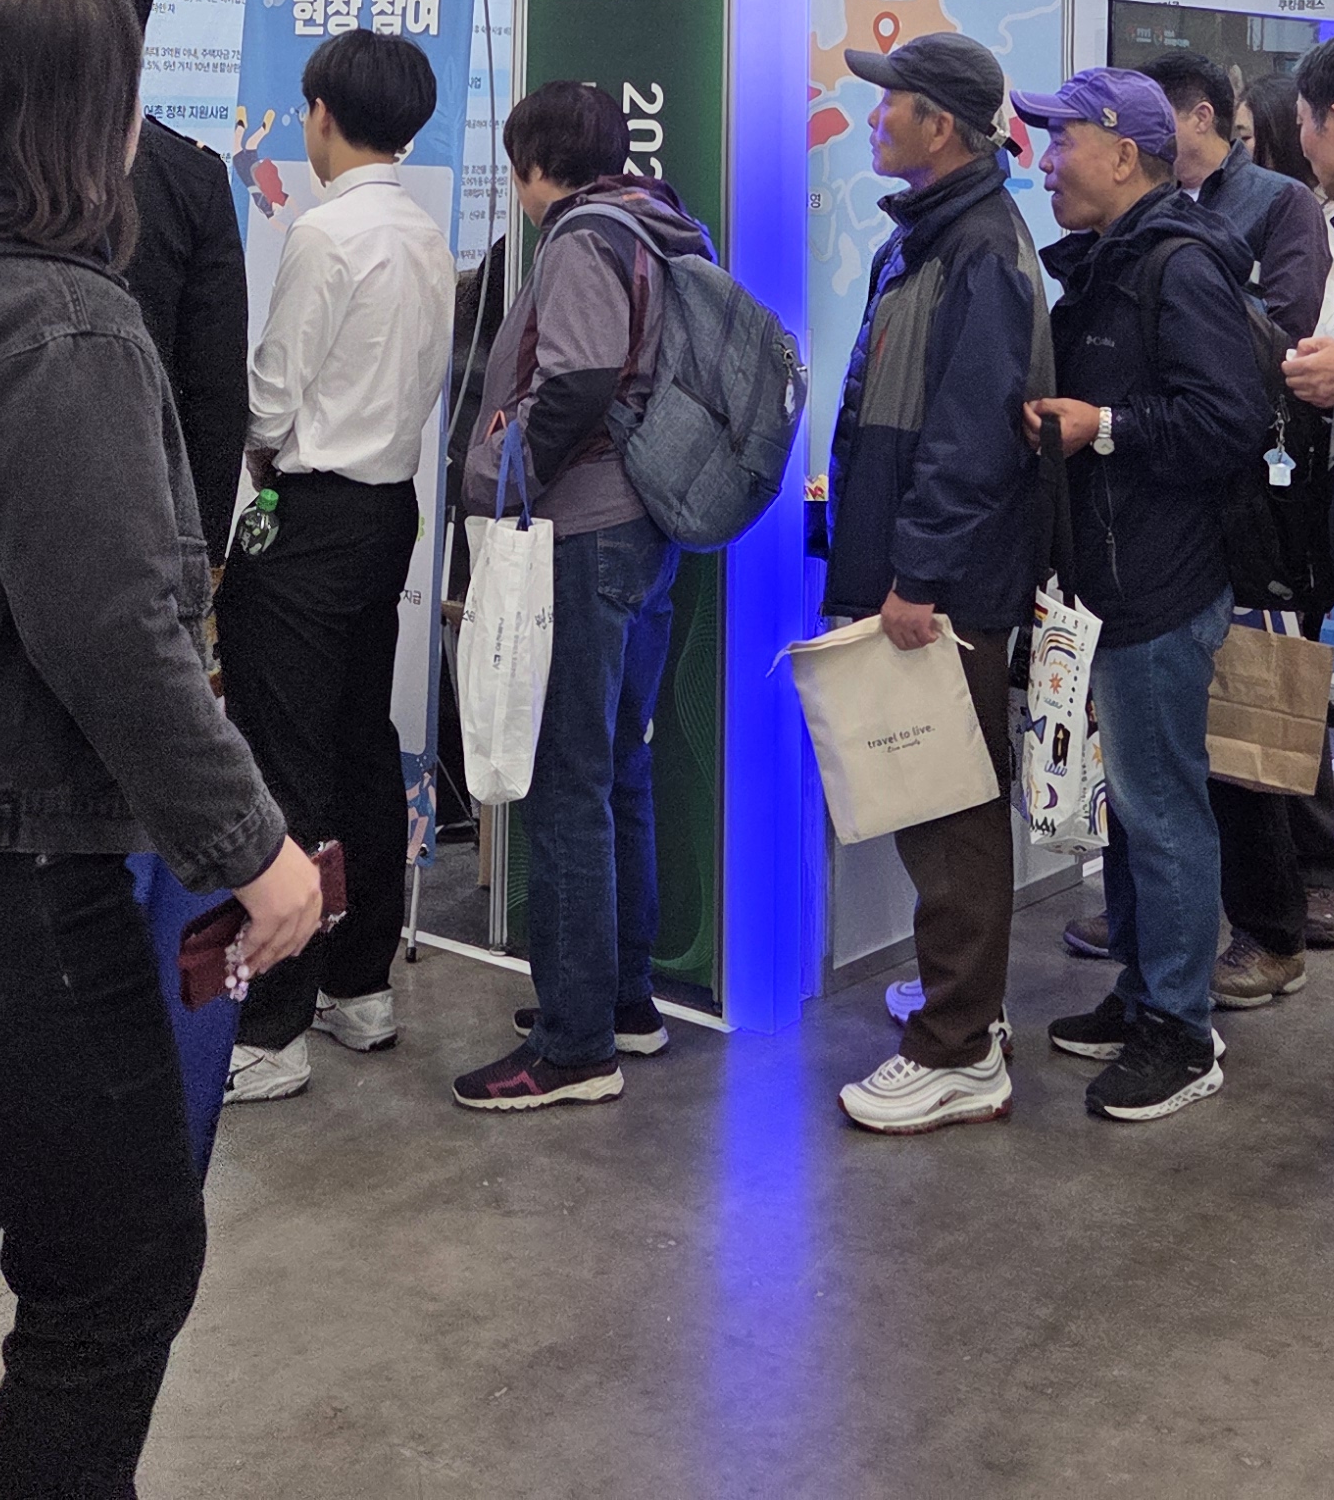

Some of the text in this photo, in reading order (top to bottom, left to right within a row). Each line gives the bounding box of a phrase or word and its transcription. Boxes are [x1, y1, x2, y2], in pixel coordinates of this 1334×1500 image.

[189, 106, 228, 120] 지원사업
[810, 193, 821, 208] 영
[867, 732, 898, 749] travel
[899, 731, 910, 740] to
